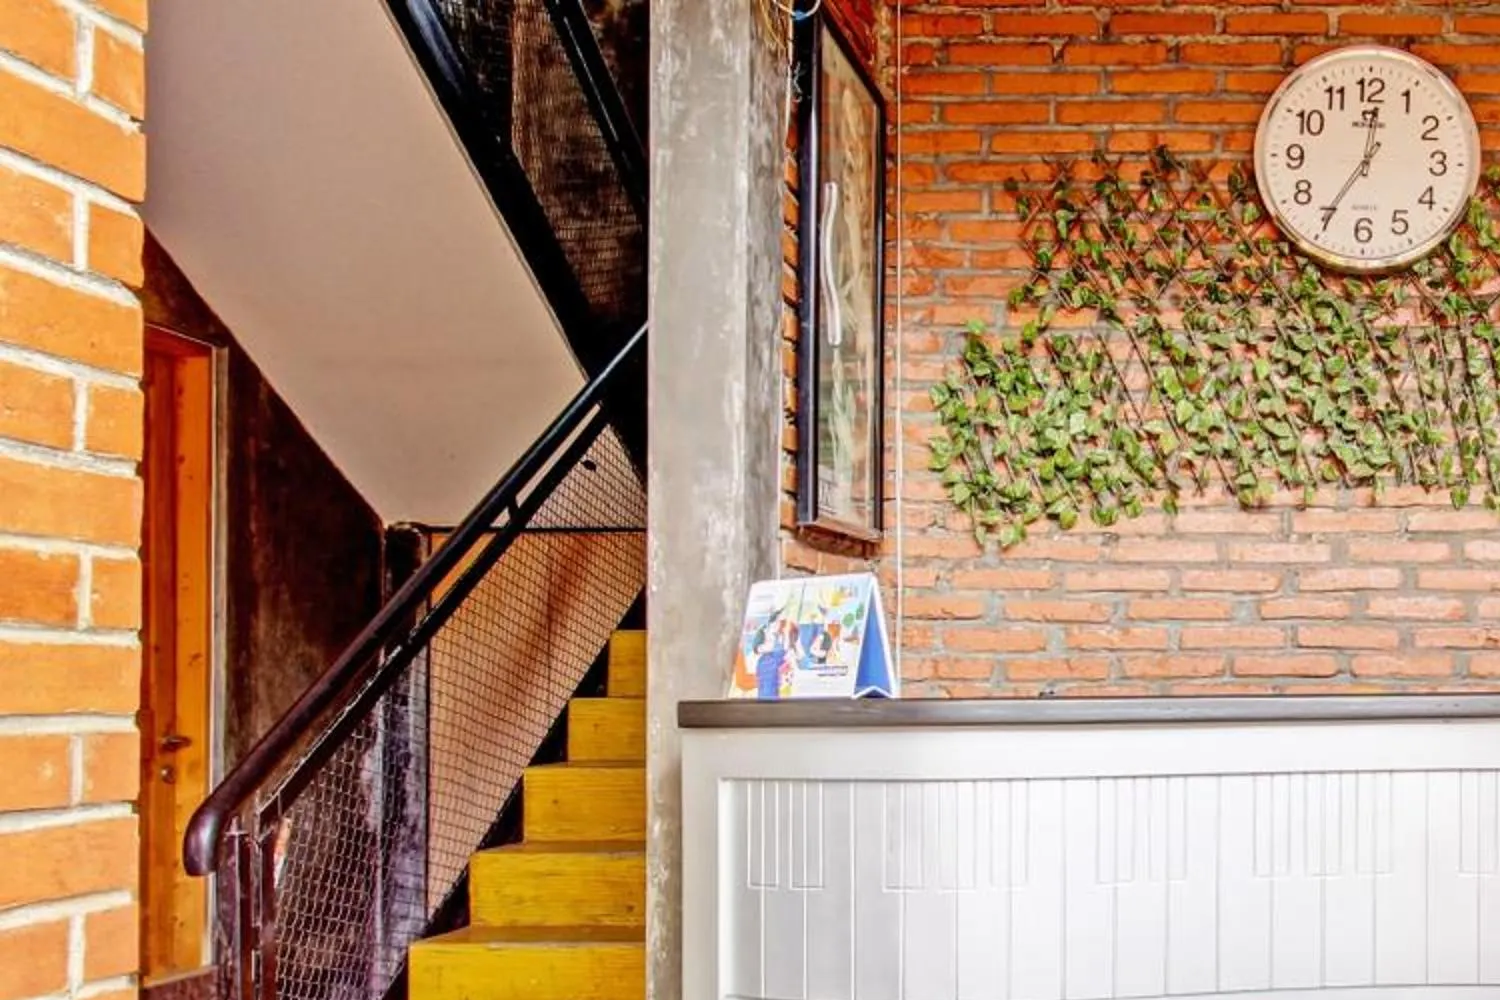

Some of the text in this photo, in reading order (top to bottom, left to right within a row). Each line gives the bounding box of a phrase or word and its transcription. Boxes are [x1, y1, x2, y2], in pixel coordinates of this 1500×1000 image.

[1324, 86, 1346, 111] 11
[1356, 78, 1385, 104] 12
[1401, 89, 1412, 115] 1
[1296, 109, 1325, 136] 10
[1421, 115, 1440, 141] 2
[1285, 144, 1305, 170] 9
[1429, 151, 1448, 176] 3
[1293, 179, 1312, 205] 8
[1418, 185, 1437, 211] 4
[1320, 206, 1338, 232] 7
[1354, 217, 1374, 243] 6
[1391, 209, 1409, 235] 5
